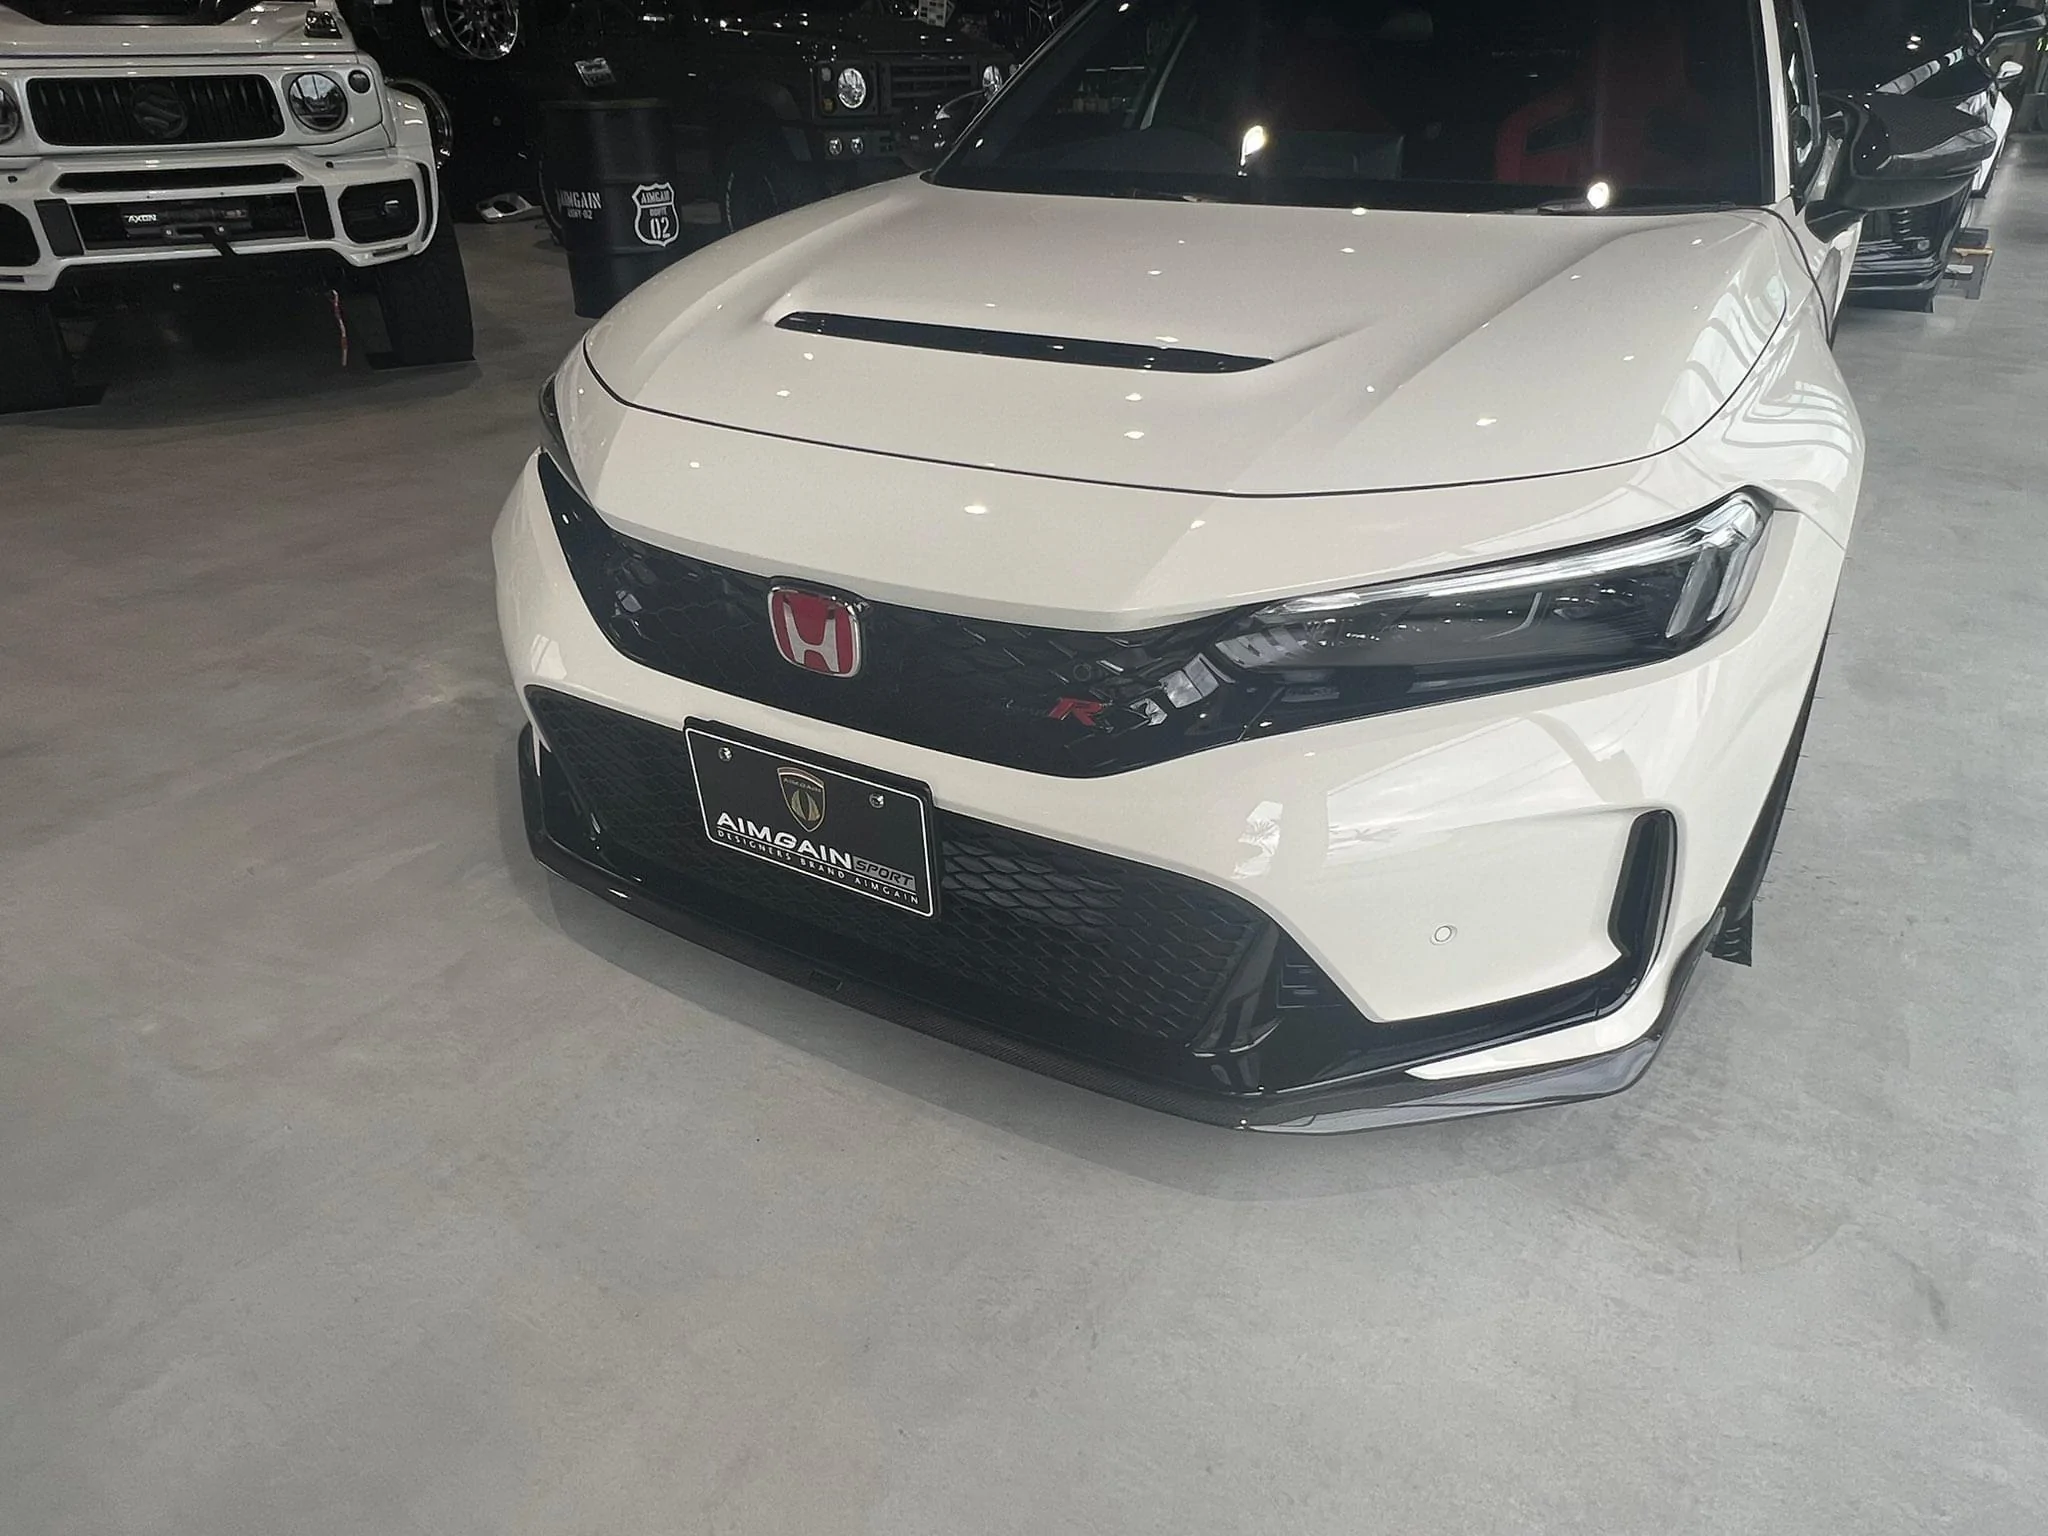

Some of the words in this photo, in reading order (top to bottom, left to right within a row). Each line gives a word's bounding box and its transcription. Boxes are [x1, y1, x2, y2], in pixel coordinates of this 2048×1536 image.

[650, 216, 671, 240] 02
[1048, 697, 1103, 726] R
[717, 812, 852, 869] AIMGAIN
[856, 860, 913, 886] SPORT
[718, 829, 791, 861] DESIGNERS
[800, 858, 845, 879] BRAND
[855, 877, 919, 904] AIMGAIN
